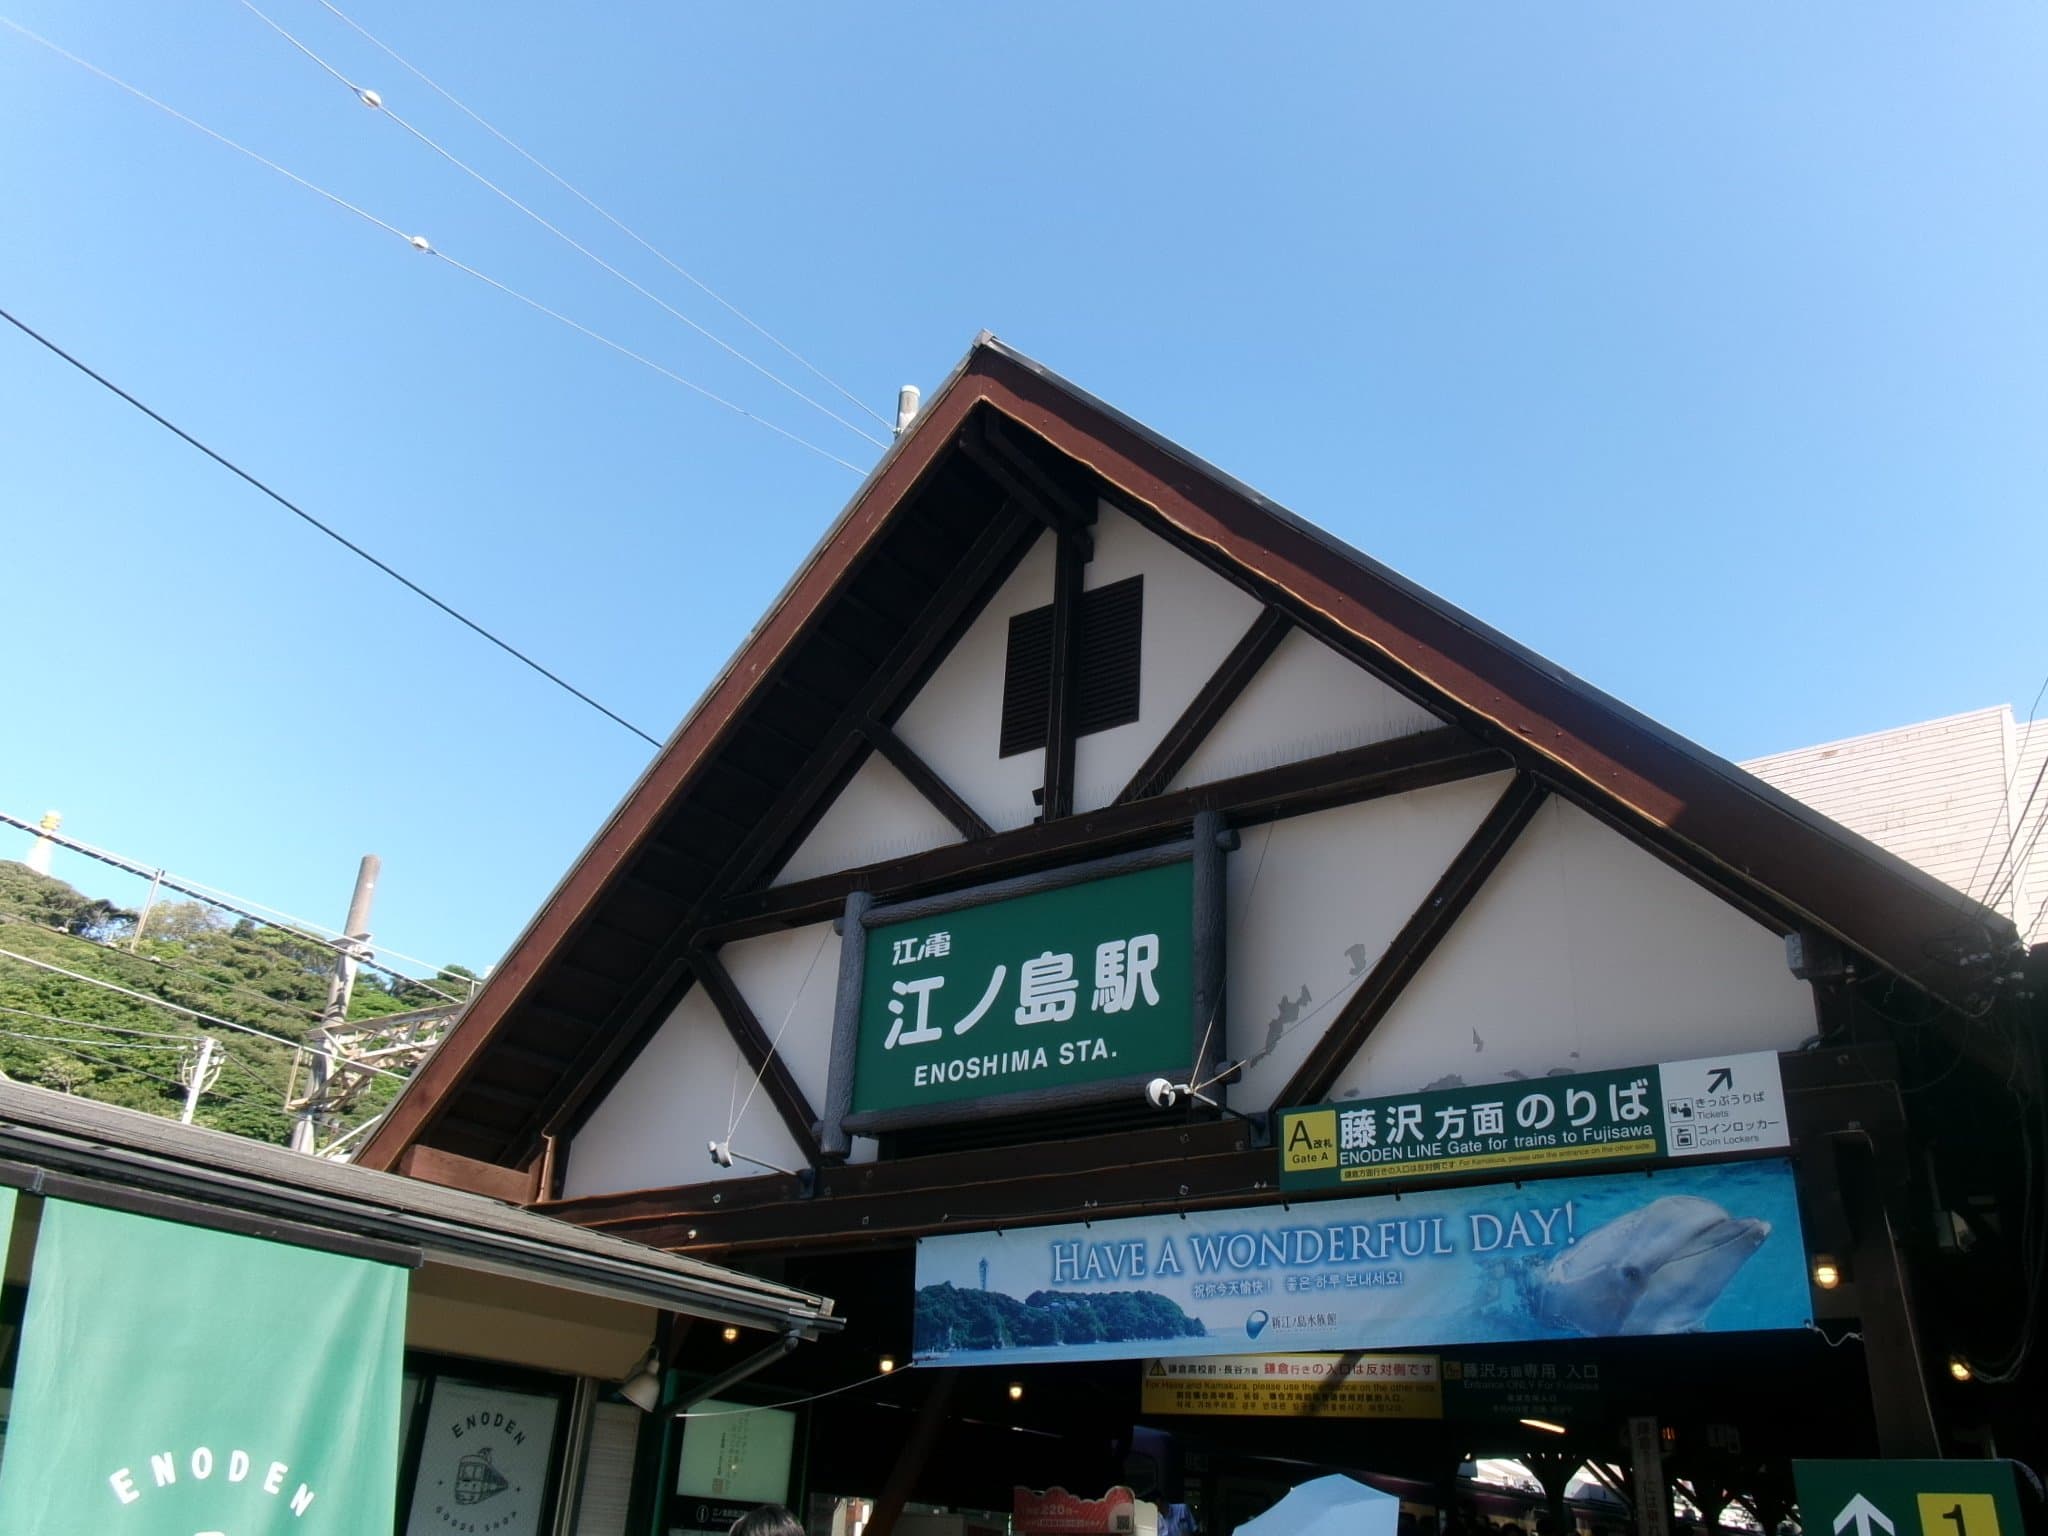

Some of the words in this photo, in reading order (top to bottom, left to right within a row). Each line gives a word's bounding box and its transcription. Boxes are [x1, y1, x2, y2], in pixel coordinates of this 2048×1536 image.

[892, 931, 950, 966] 江ノ電
[884, 933, 1160, 1050] 江ノ島駅
[914, 1047, 1048, 1087] ENOSHIMA
[1059, 1037, 1117, 1065] STA.
[1340, 1077, 1650, 1149] 藤沢方面のりば
[1697, 1110, 1728, 1119] Tickets
[1698, 1120, 1779, 1134] コインロッカー
[1288, 1119, 1313, 1152] A
[1313, 1138, 1333, 1149] 改札
[1340, 1147, 1403, 1166] ENODEN
[1407, 1143, 1442, 1159] LINE
[1447, 1139, 1482, 1155] Gate
[1488, 1136, 1508, 1150] for
[1514, 1132, 1556, 1148] trains
[1562, 1131, 1577, 1144] to
[1583, 1124, 1653, 1143] Fujisawa
[1699, 1137, 1721, 1146] Coin
[1724, 1135, 1759, 1145] Lockers
[1292, 1154, 1317, 1164] Gate
[1320, 1153, 1329, 1161] A
[1051, 1240, 1145, 1282] HAVE
[1156, 1238, 1181, 1275] A
[1191, 1218, 1453, 1272] WONDERFUL
[1469, 1200, 1576, 1253] DAY!
[1316, 1274, 1340, 1289] 하루
[1346, 1271, 1403, 1287] 보내세요!
[452, 1411, 527, 1446] ENODEN
[109, 1446, 315, 1517] ENODEN
